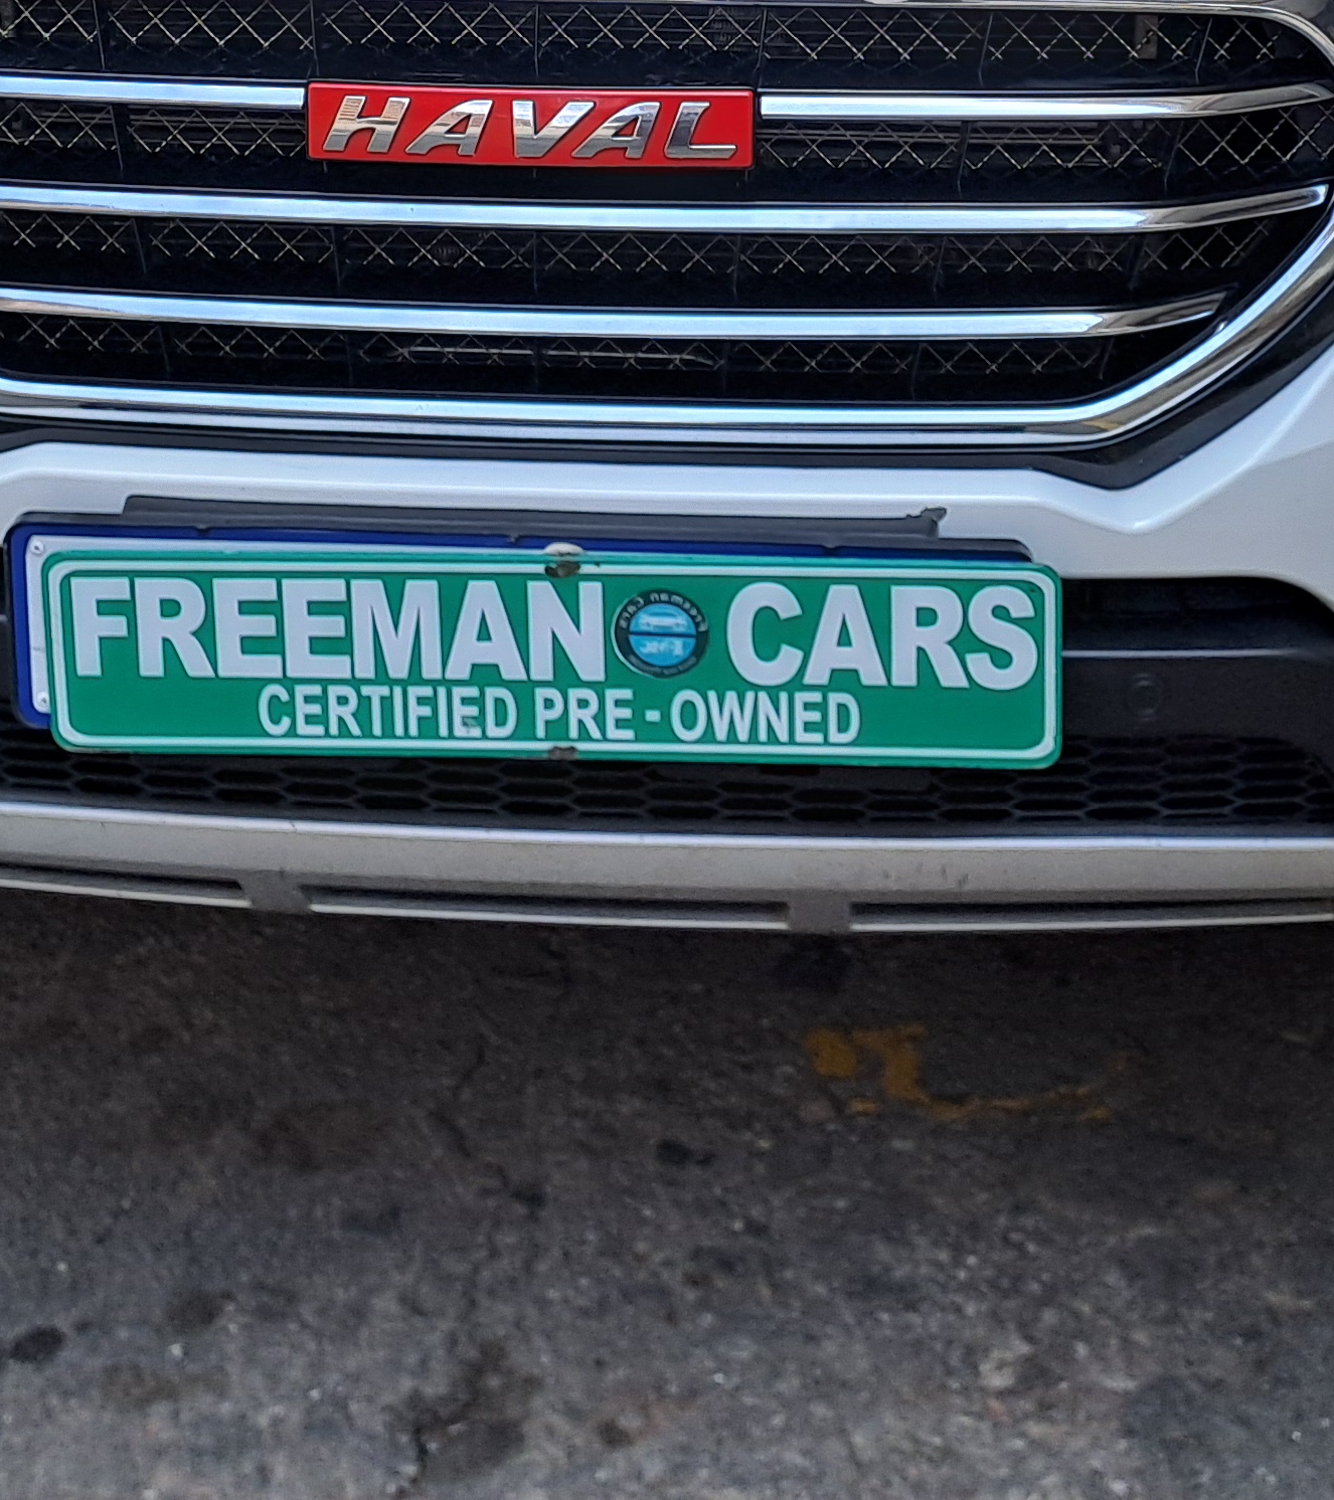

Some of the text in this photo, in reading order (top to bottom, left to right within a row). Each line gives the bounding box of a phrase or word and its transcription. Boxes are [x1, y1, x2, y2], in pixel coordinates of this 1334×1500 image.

[322, 94, 738, 160] HAVAL
[69, 576, 1040, 690] FREEMAN CARS
[258, 684, 518, 740] CERTIFIED
